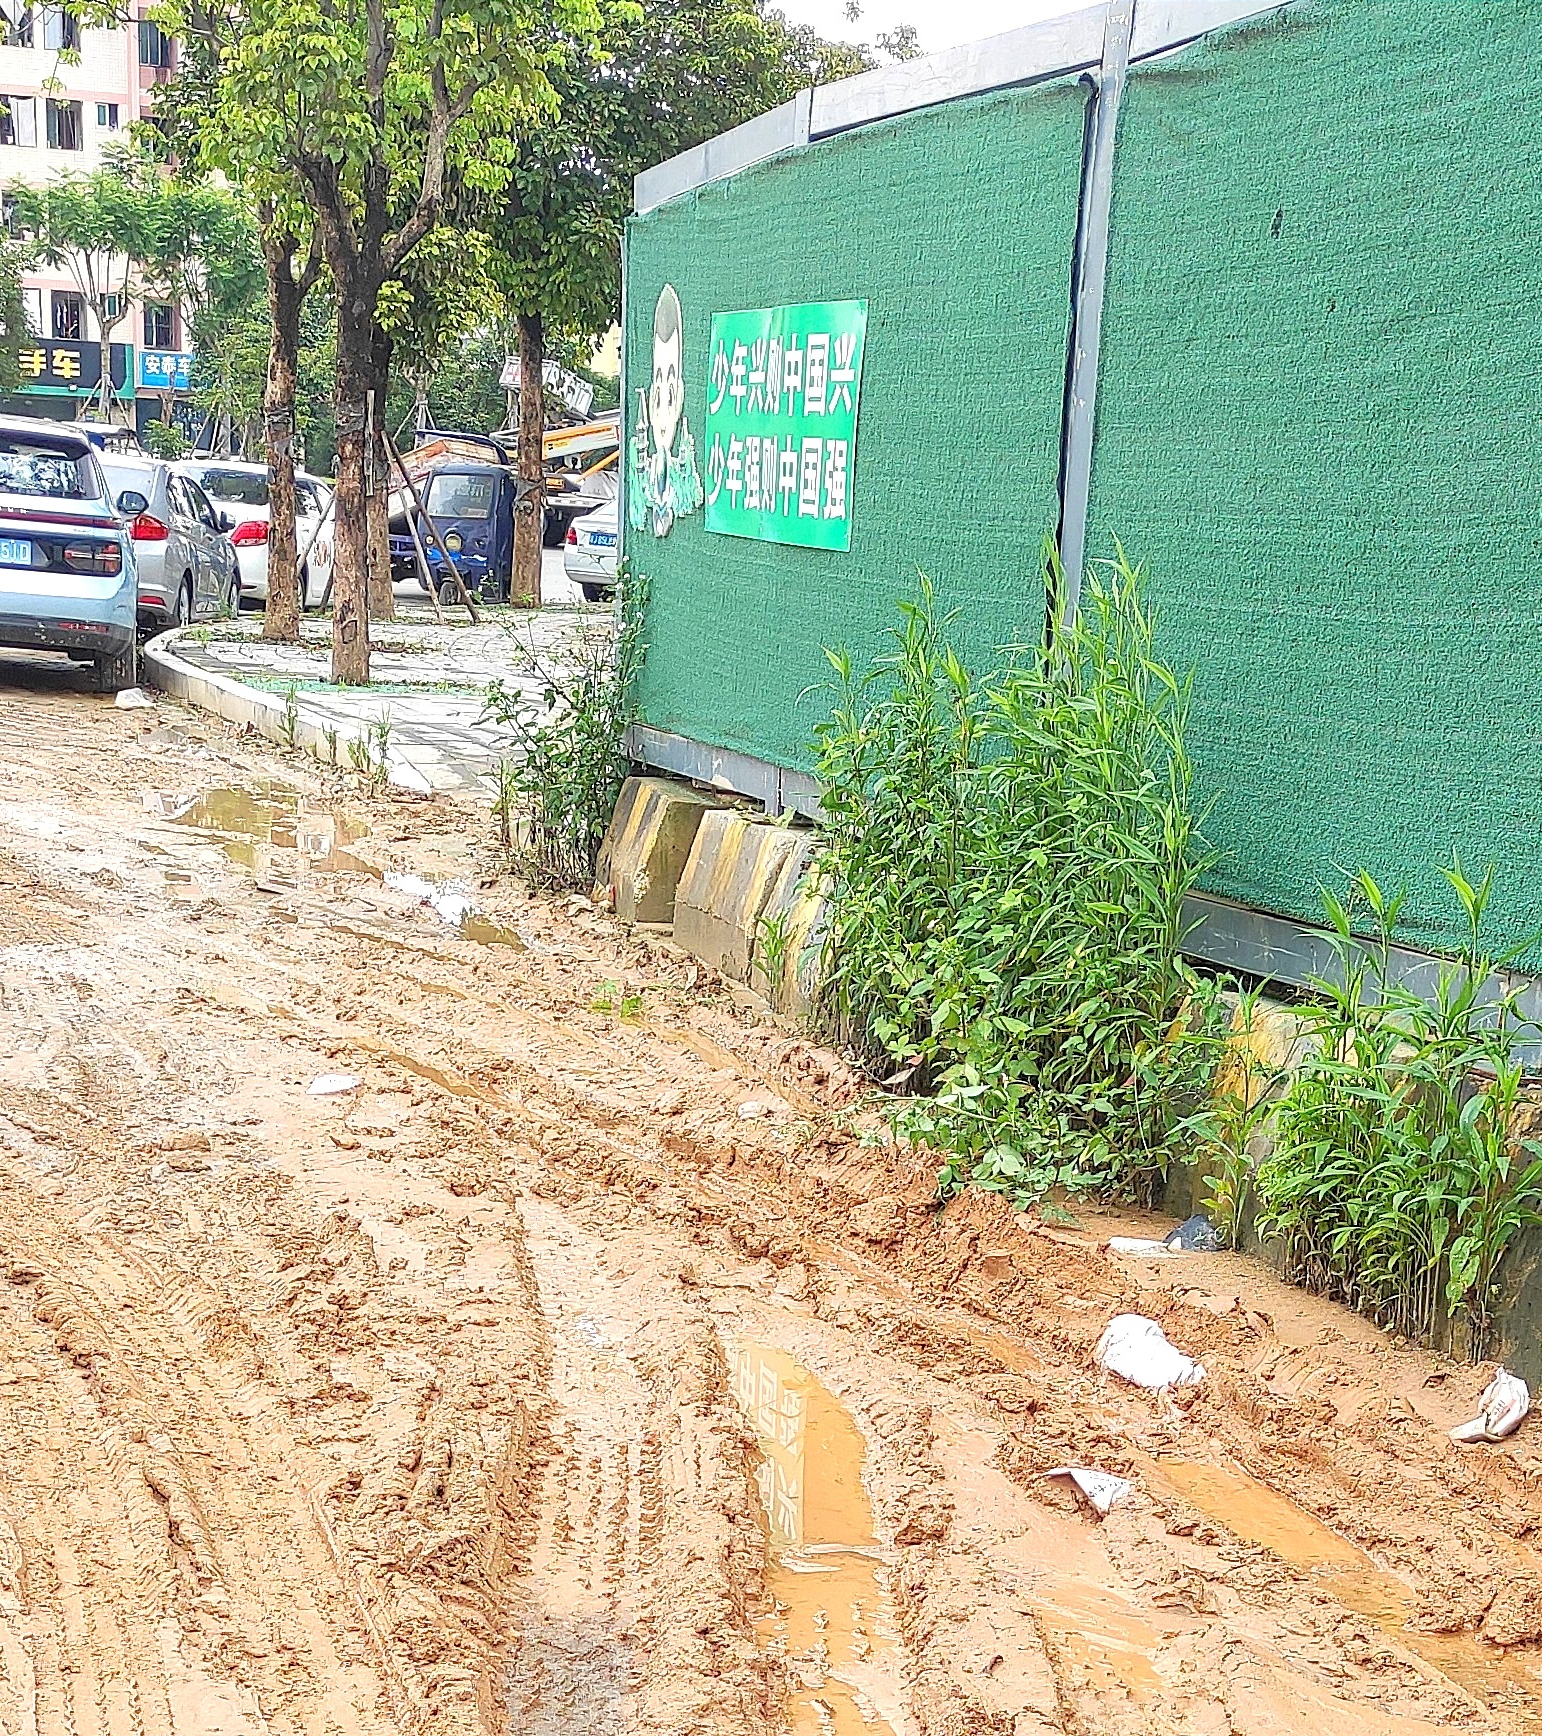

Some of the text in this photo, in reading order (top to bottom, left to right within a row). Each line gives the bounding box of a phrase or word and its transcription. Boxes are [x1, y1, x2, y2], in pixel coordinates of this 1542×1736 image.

[709, 332, 857, 417] 少年兴则中国兴
[708, 432, 848, 520] 少年强则中国强
